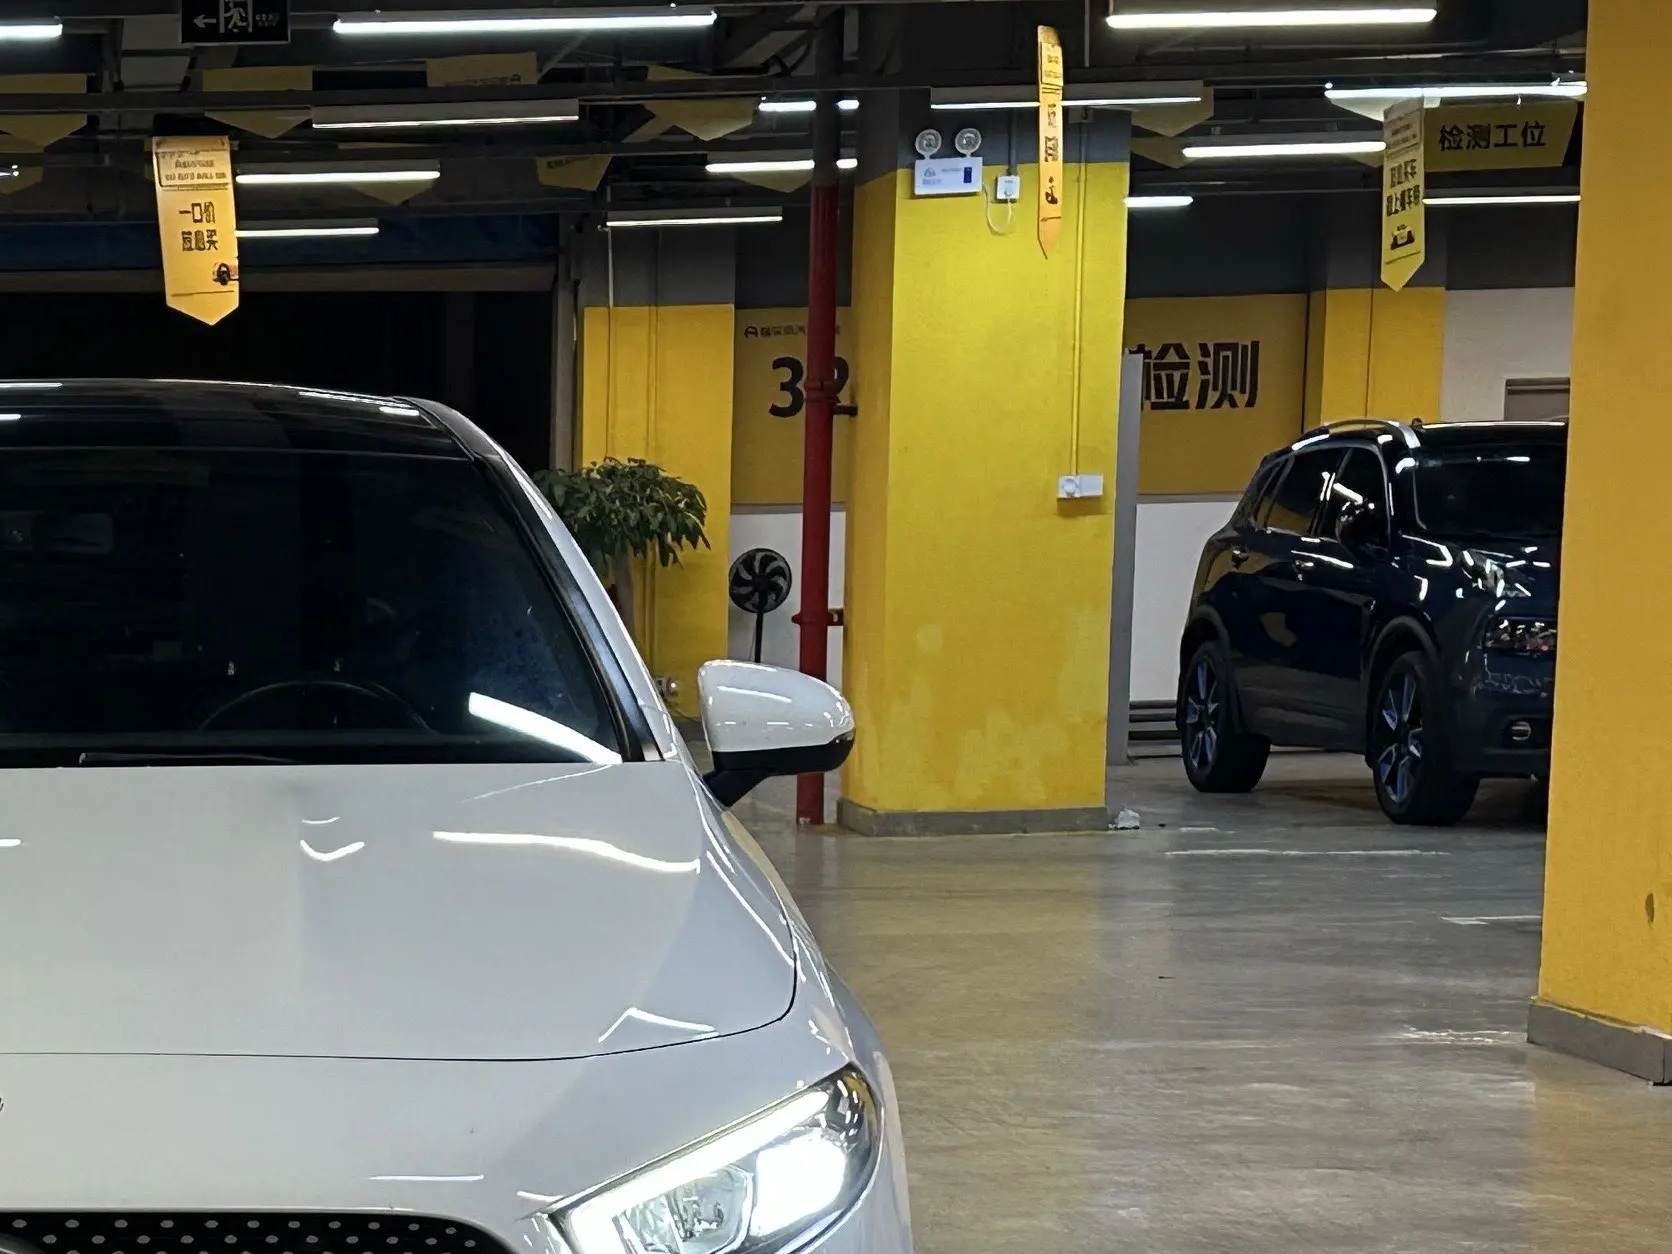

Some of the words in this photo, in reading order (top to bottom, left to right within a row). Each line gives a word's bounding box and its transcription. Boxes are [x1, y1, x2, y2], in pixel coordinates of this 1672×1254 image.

[1439, 121, 1547, 152] 检测工位
[1128, 340, 1260, 411] 检测
